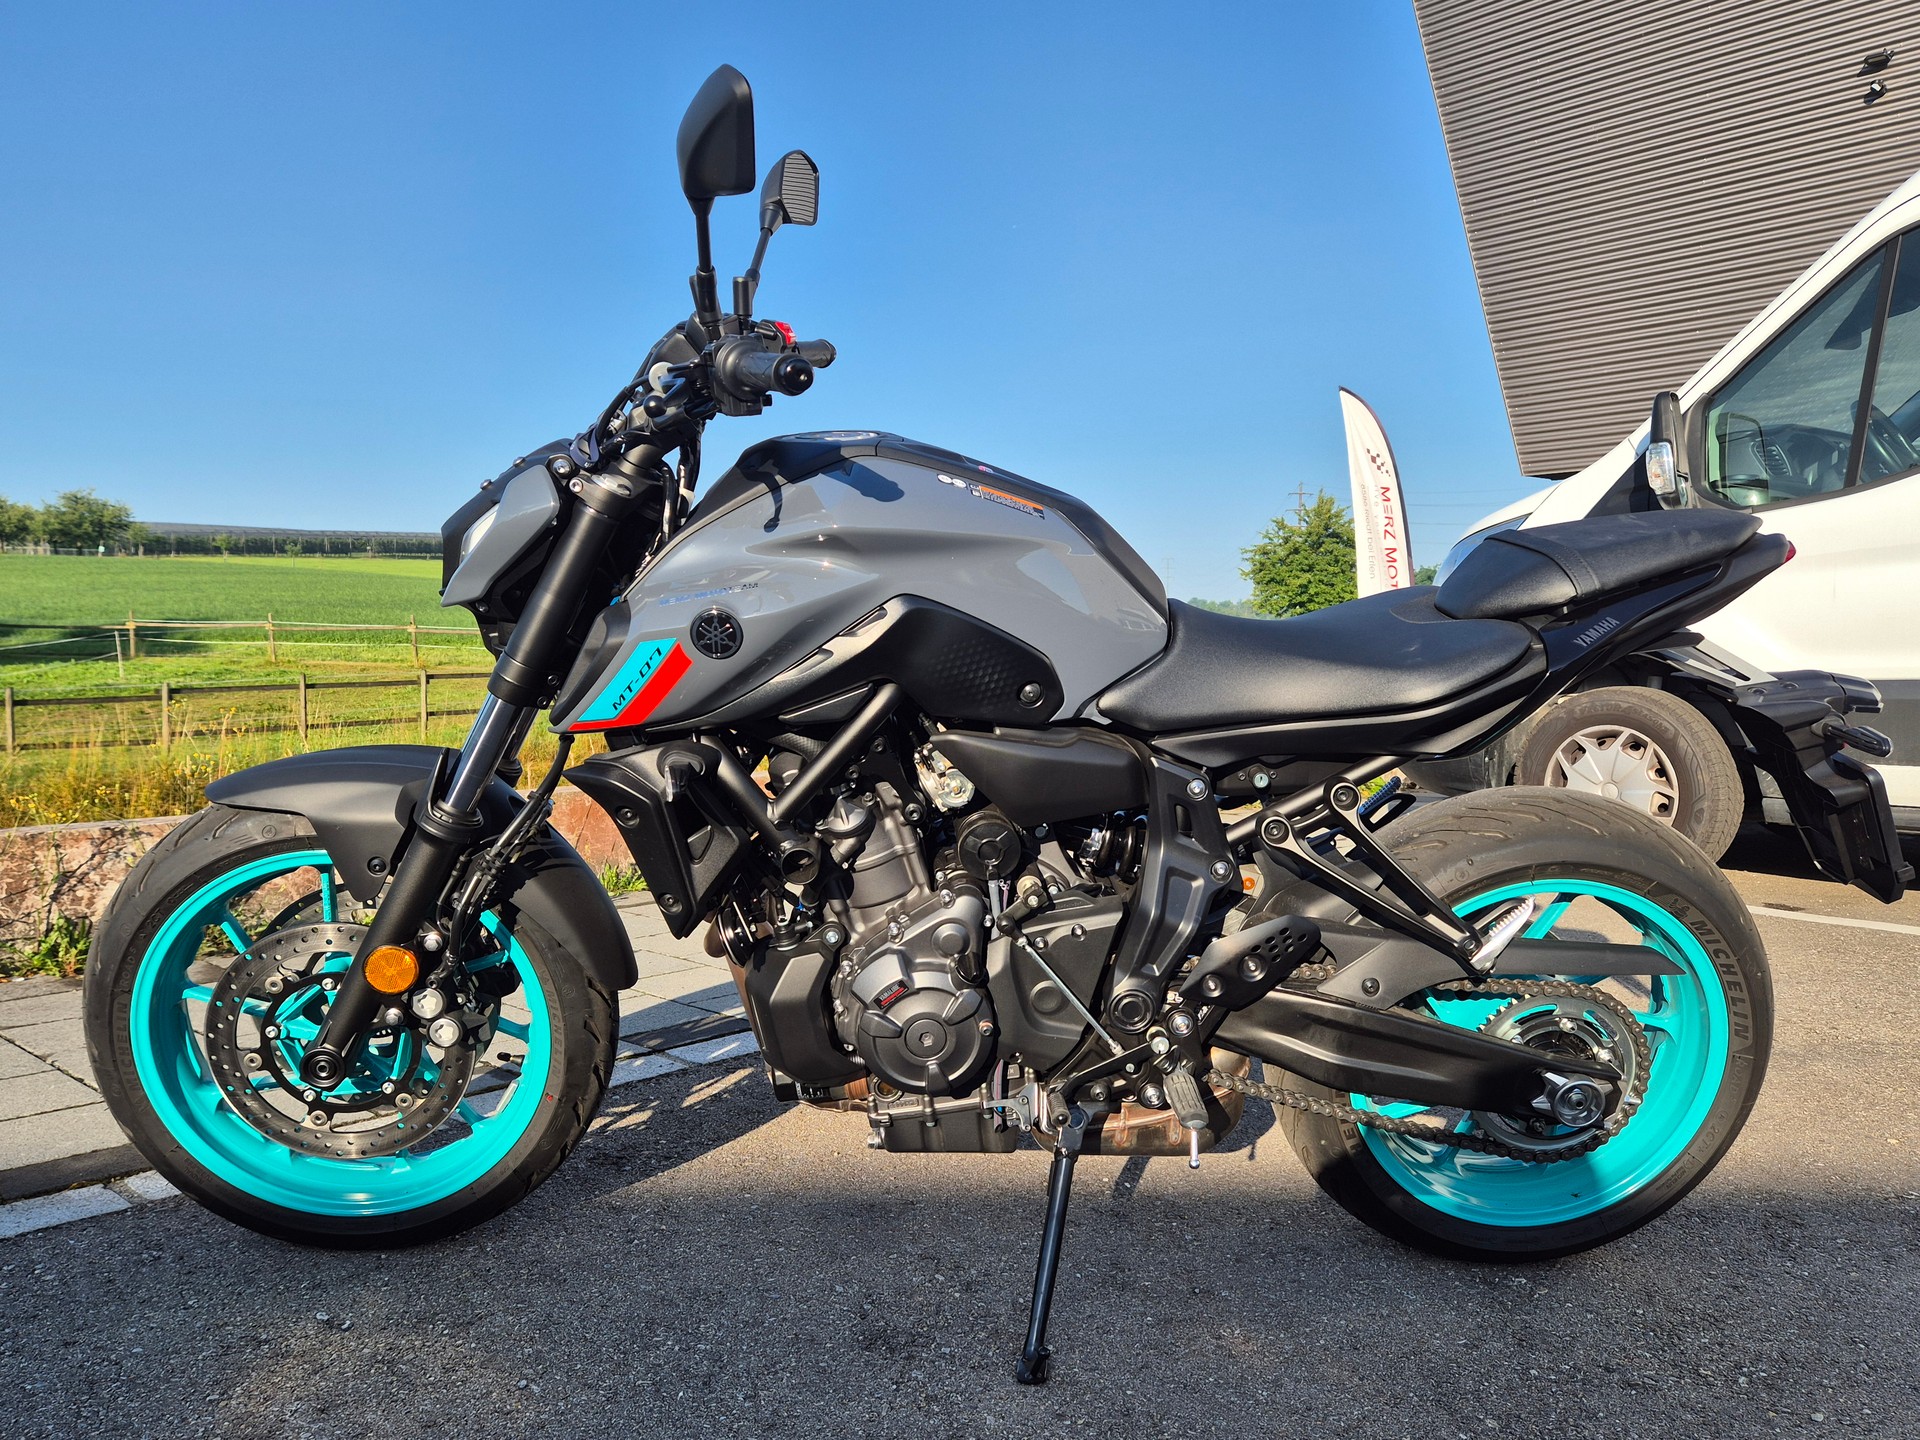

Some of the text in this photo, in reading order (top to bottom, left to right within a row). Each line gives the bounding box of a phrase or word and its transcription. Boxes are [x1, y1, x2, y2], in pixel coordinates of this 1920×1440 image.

[1380, 486, 1396, 540] MERZ
[1573, 616, 1620, 647] YAMAHA
[612, 647, 662, 710] MT-07
[1690, 919, 1749, 1041] MICHELIN
[115, 1001, 141, 1092] MICHELIN
[545, 988, 563, 1079] MICHELIN
